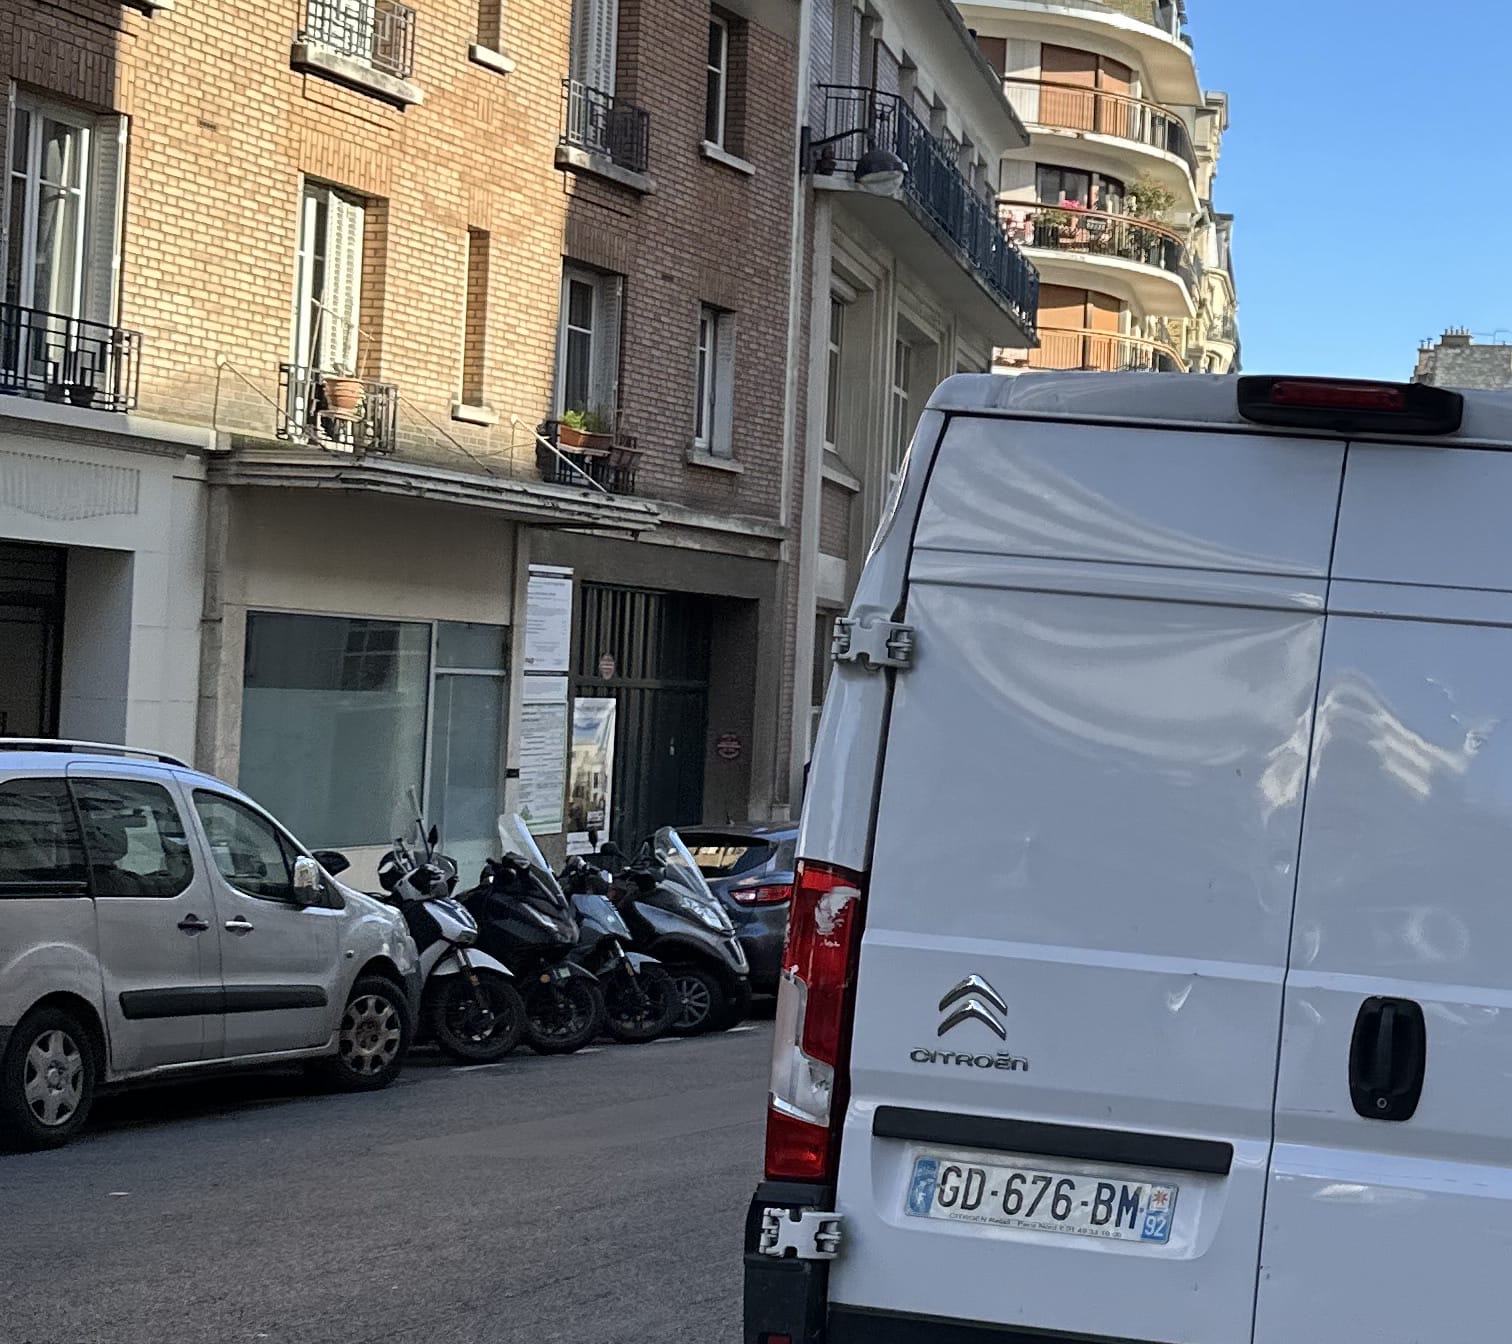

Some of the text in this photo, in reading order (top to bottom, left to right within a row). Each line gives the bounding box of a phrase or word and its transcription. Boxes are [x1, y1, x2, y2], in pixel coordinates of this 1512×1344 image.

[910, 1047, 1029, 1072] CITROËN
[937, 1165, 1143, 1230] GD-676-BM
[1143, 1216, 1165, 1238] 92
